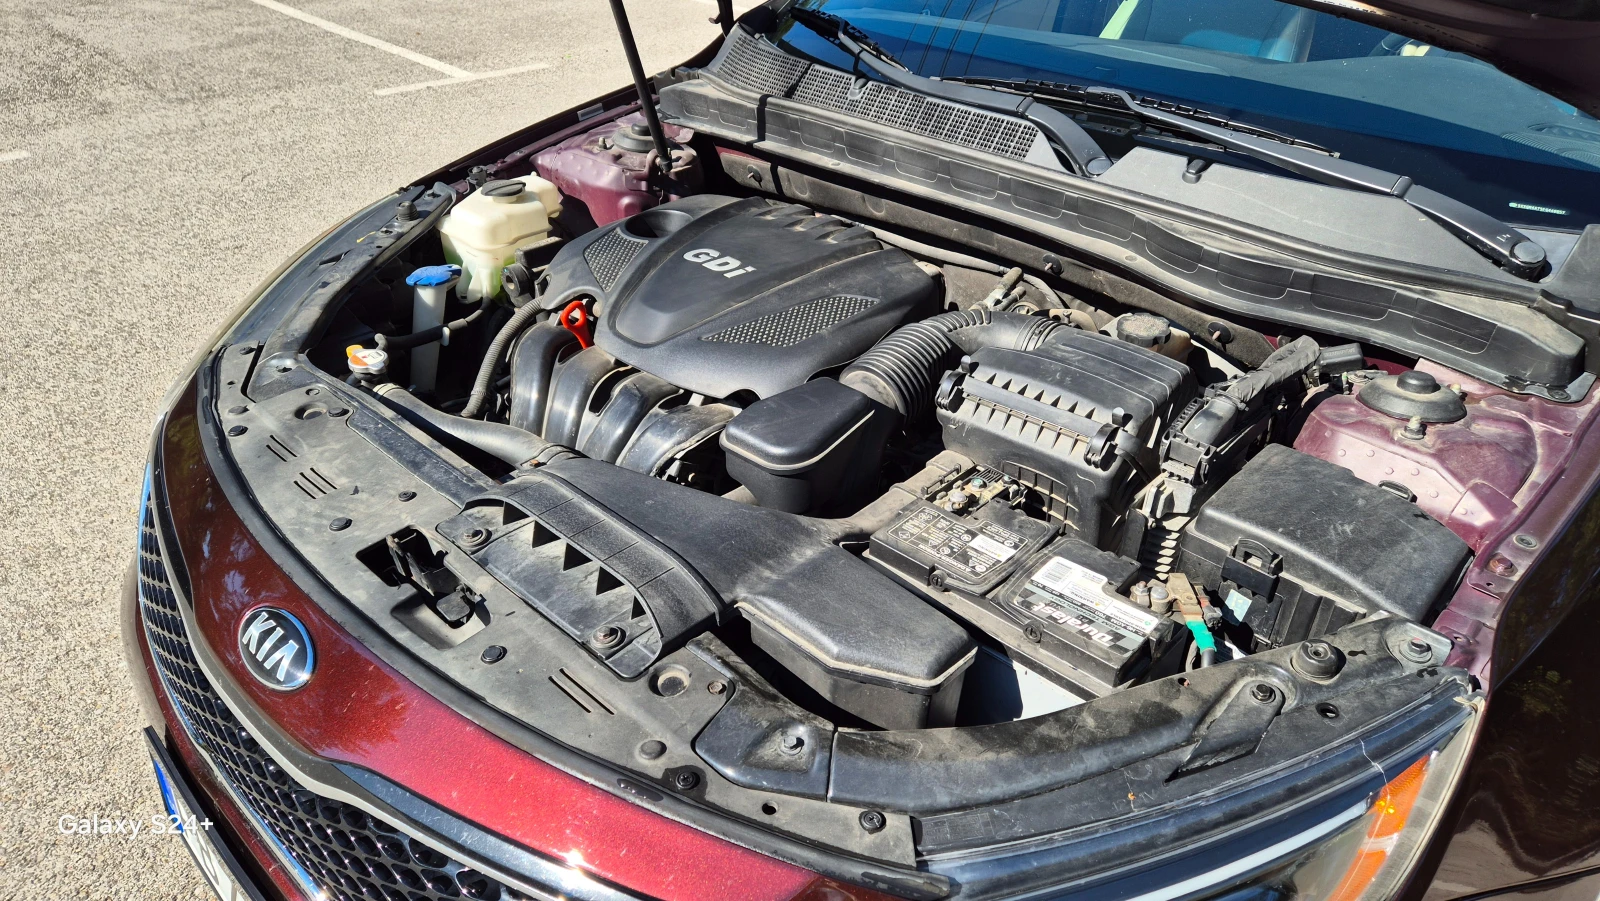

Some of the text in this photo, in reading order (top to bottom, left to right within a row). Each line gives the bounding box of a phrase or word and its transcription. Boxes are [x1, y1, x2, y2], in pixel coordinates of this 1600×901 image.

[683, 248, 757, 279] GDi
[242, 611, 299, 681] KIA
[1031, 601, 1113, 647] Duralast
